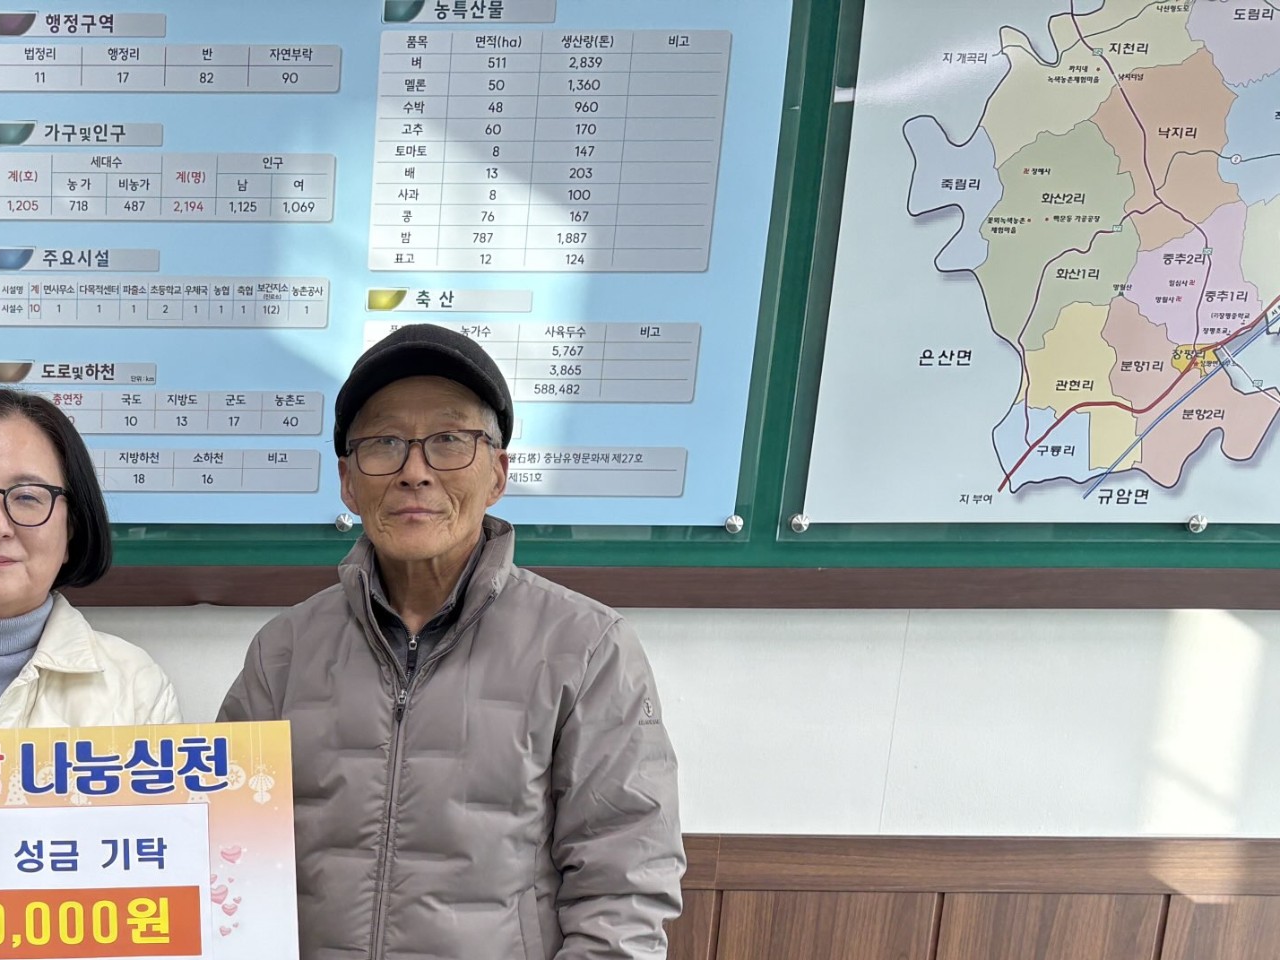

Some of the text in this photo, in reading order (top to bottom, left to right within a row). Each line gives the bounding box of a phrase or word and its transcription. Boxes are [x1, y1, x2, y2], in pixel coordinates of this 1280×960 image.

[434, 0, 505, 20] 농특산물
[1233, 8, 1274, 21] 도림리
[45, 14, 115, 34] 행정구역
[406, 35, 690, 49] 품목 면적(ha) 생산량(톤) 비고
[1108, 42, 1149, 55] 지천리
[24, 47, 314, 62] 법정리 행정리 반 자연부락
[957, 52, 988, 65] 개곡리
[411, 57, 603, 70] 벼 511 2,839
[34, 72, 299, 84] 11 17 82 90
[404, 79, 601, 93] 멜론 50 1,360
[403, 101, 599, 114] 수박 48 960
[401, 123, 597, 136] 고추 60 170
[1158, 127, 1198, 139] 낙지리
[395, 145, 595, 158] 토마토 8 147
[90, 155, 284, 170] 세대수 인구
[7, 170, 206, 184] 계(호) 계(명)
[404, 167, 593, 180] 배 13 203
[118, 178, 150, 191] 비농가
[237, 178, 248, 192] 남
[293, 178, 305, 192] 여
[941, 178, 981, 190] 죽림리
[397, 188, 591, 202] 사과 8 100
[1040, 192, 1086, 204] 화산2리
[6, 200, 315, 215] 1,205 718 487 2,194 1,125 1,069
[402, 210, 589, 223] 콩 76 167
[401, 231, 587, 245] 밤 787 1,887
[42, 249, 110, 268] 주요시설
[394, 253, 585, 265] 표고 12 124
[1163, 254, 1206, 265] 중추2리
[1056, 268, 1100, 281] 화산1리
[2, 285, 24, 296] 시설명
[43, 284, 75, 296] 면사무소
[79, 284, 120, 296] 다목적센터
[122, 285, 147, 296] 파출소
[150, 285, 182, 296] 초등학교
[184, 285, 208, 296] 우체국
[214, 285, 230, 296] 농협
[237, 285, 253, 297] 축협
[257, 283, 289, 295] 보건지소
[292, 286, 324, 297] 농촌공사
[1205, 291, 1249, 303] 중추1리
[2, 303, 309, 316] 시설수 10 1 1 1 2 1 1 1 1(2) 1
[460, 325, 661, 339] 농가수 사육두수 비고
[552, 345, 584, 358] 5,767
[919, 350, 972, 366] 은산면
[41, 363, 115, 381] 도로및하천
[549, 365, 582, 377] 3,865
[1120, 360, 1164, 373] 분향1리
[533, 384, 580, 397] 588,482
[1055, 380, 1094, 391] 관현리
[52, 393, 306, 407] 총연장 국도 지방도 군도 농촌도
[1182, 408, 1225, 421] 분향2리
[124, 415, 299, 428] 10 13 17 40
[119, 452, 289, 465] 지방하천 소하천 비고
[544, 452, 611, 465] 충남유형문화재
[612, 453, 644, 465] 제27호
[133, 473, 214, 485] 18 16
[508, 472, 543, 484] 제151호
[1098, 489, 1150, 505] 규암면
[21, 736, 229, 795] 나눔실천
[14, 840, 80, 872] 성금
[101, 838, 167, 870] 기탁
